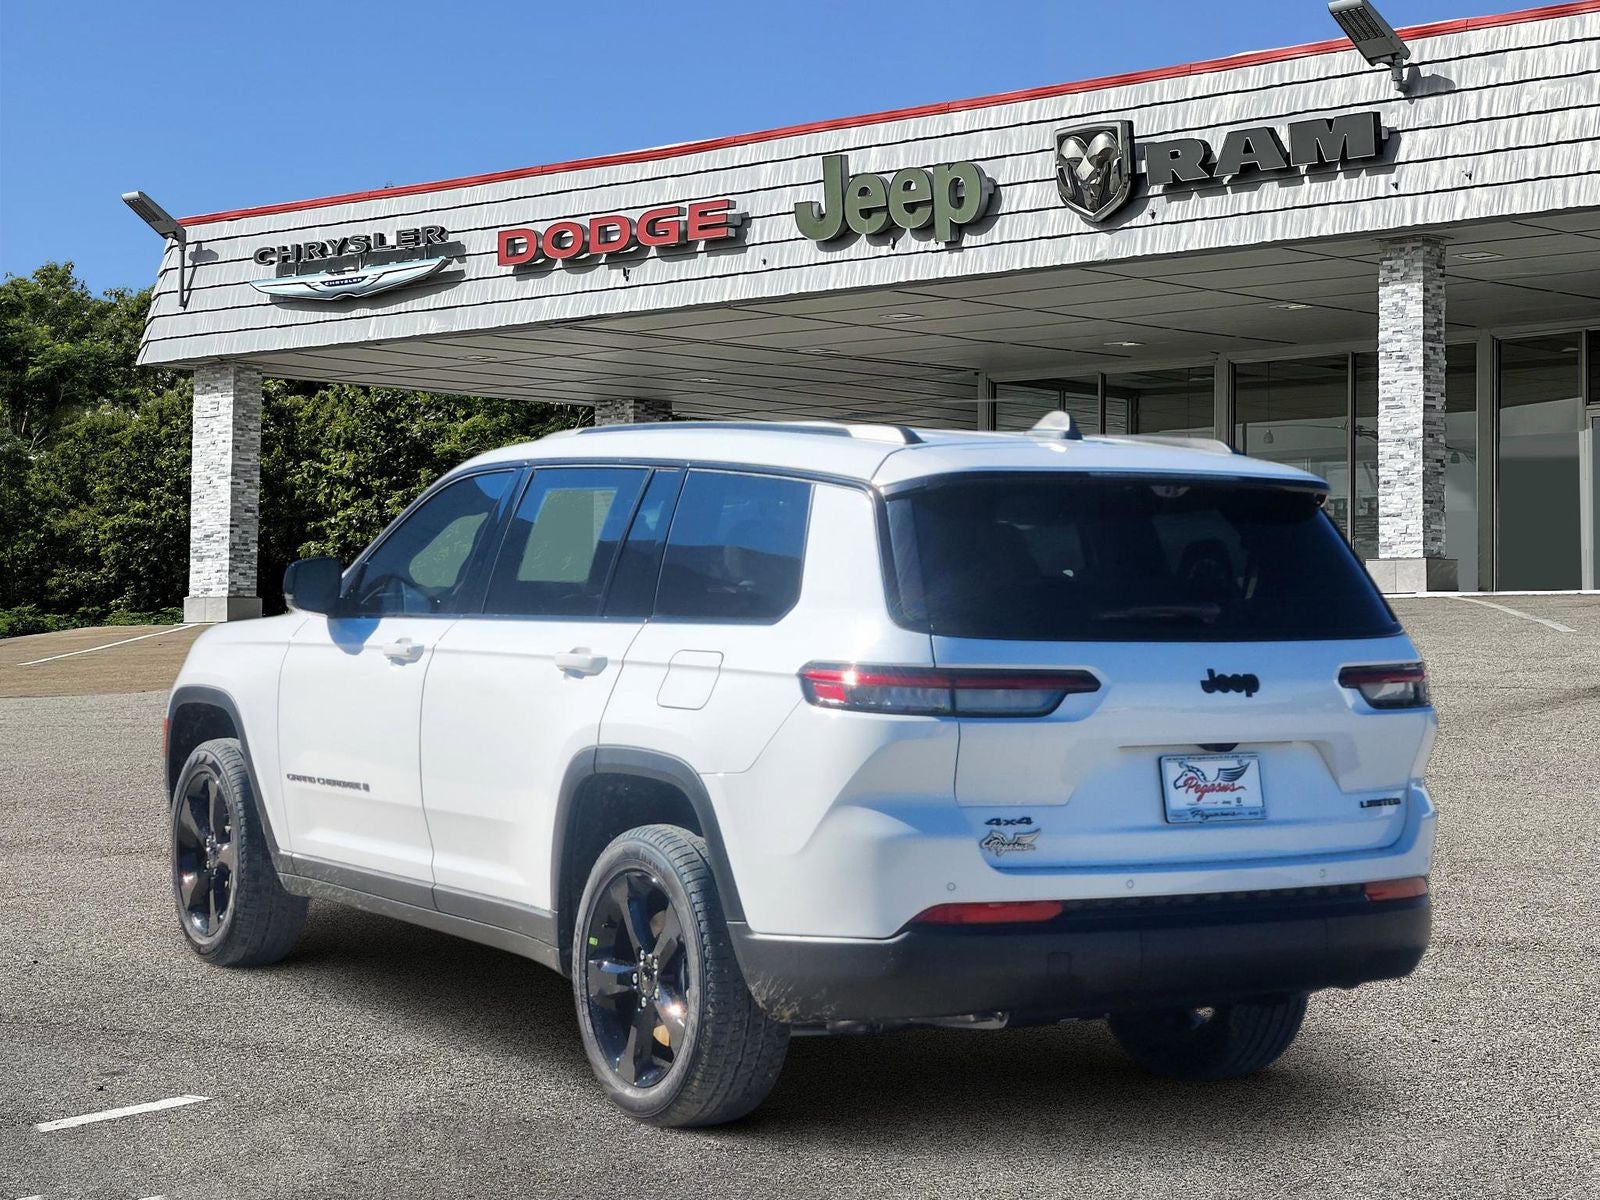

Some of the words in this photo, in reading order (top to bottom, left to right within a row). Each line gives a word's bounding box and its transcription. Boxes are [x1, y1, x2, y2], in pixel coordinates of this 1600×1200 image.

[1144, 111, 1380, 186] RAM
[794, 154, 987, 242] Jeep
[253, 224, 449, 267] CHRYSLER
[497, 199, 736, 267] DODGE
[323, 276, 364, 287] CHRYSLER
[1200, 668, 1260, 698] Jeep
[286, 773, 316, 784] GRAND
[1183, 776, 1247, 802] Pegasus
